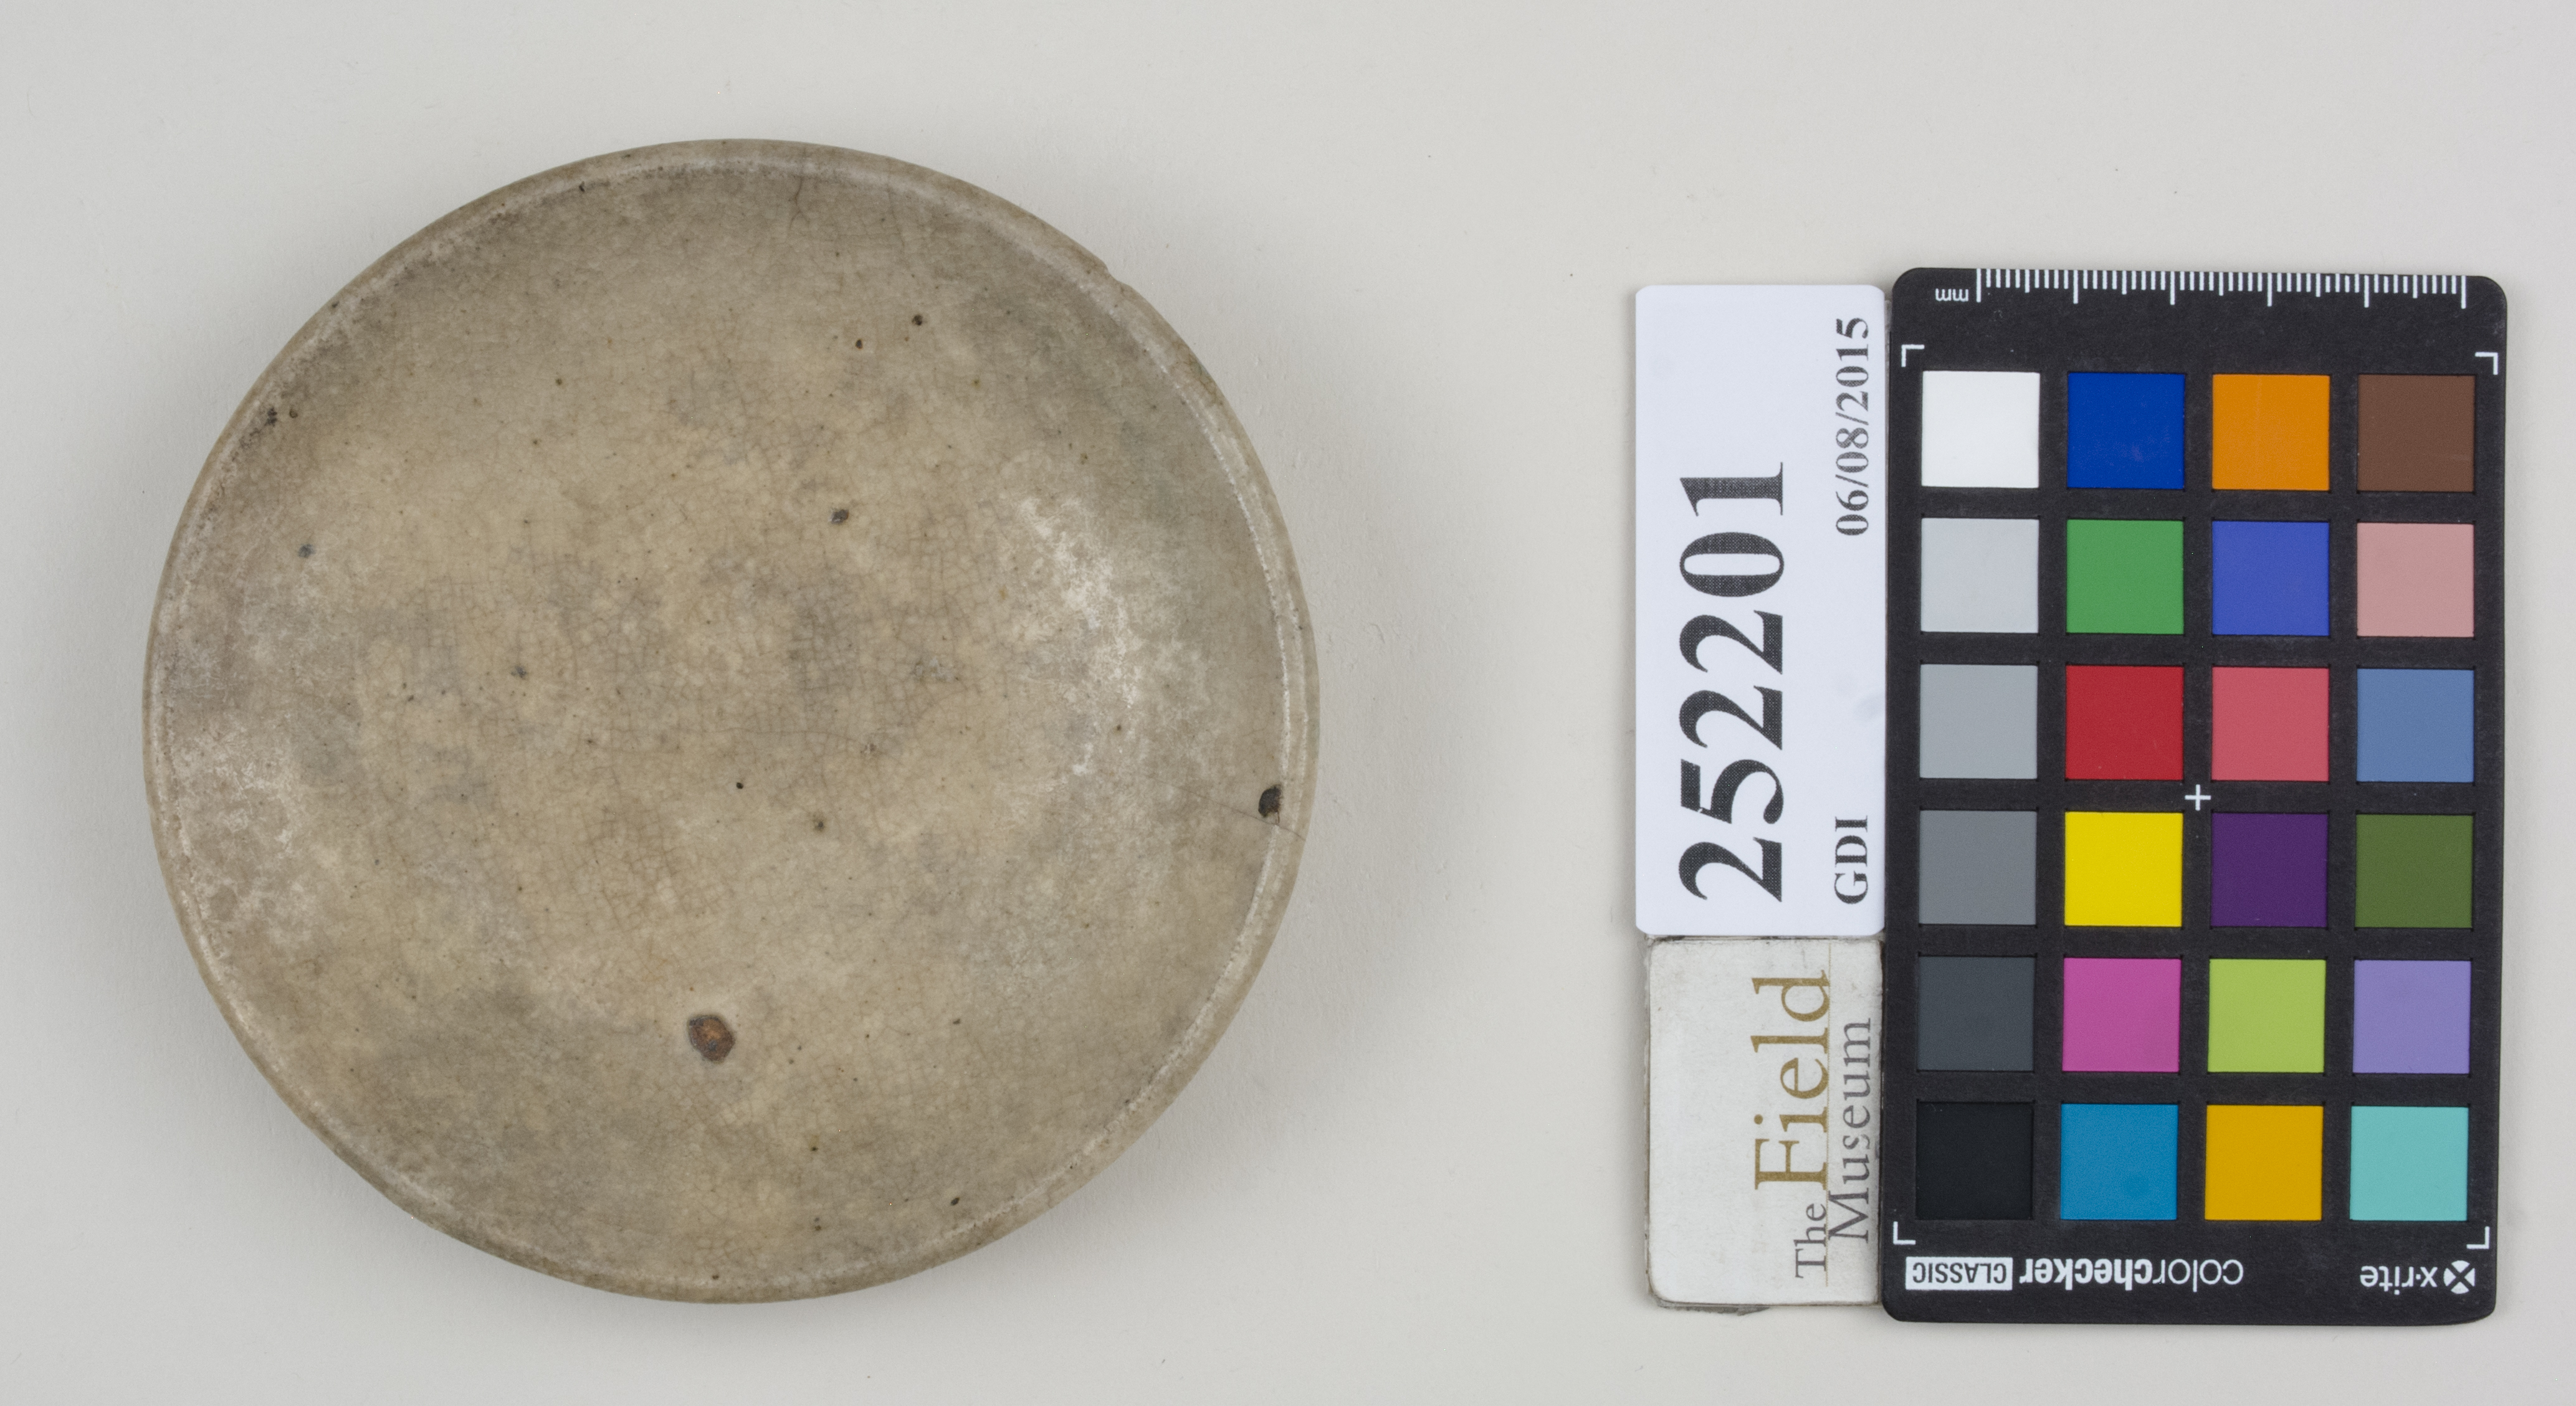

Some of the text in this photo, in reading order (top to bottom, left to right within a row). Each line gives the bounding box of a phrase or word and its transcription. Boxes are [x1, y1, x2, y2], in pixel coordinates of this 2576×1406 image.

[1935, 288, 1969, 302] mm
[1835, 318, 1869, 536] 06/08/2015
[1678, 462, 1785, 902] 252201
[1834, 818, 1868, 905] GDI
[1750, 969, 1829, 1278] The Field
[1828, 1017, 1871, 1244] Museum
[1912, 1258, 2243, 1292] colorchecker CLASSIC
